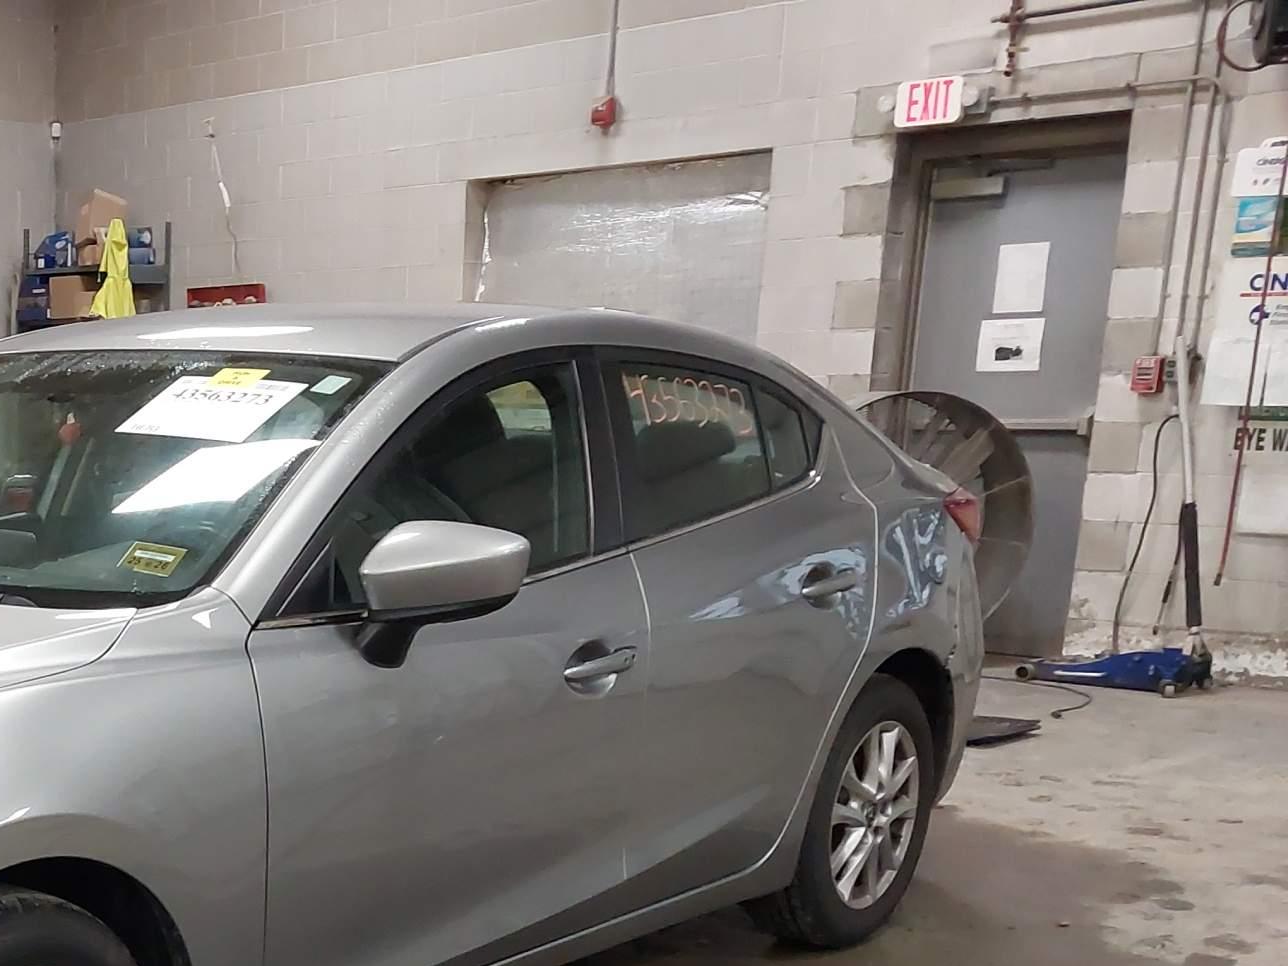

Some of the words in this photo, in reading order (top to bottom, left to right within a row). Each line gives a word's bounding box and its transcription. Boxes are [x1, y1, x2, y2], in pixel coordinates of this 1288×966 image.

[906, 79, 954, 122] EXIT
[172, 388, 274, 405] 43563273
[1234, 427, 1267, 451] EYE
